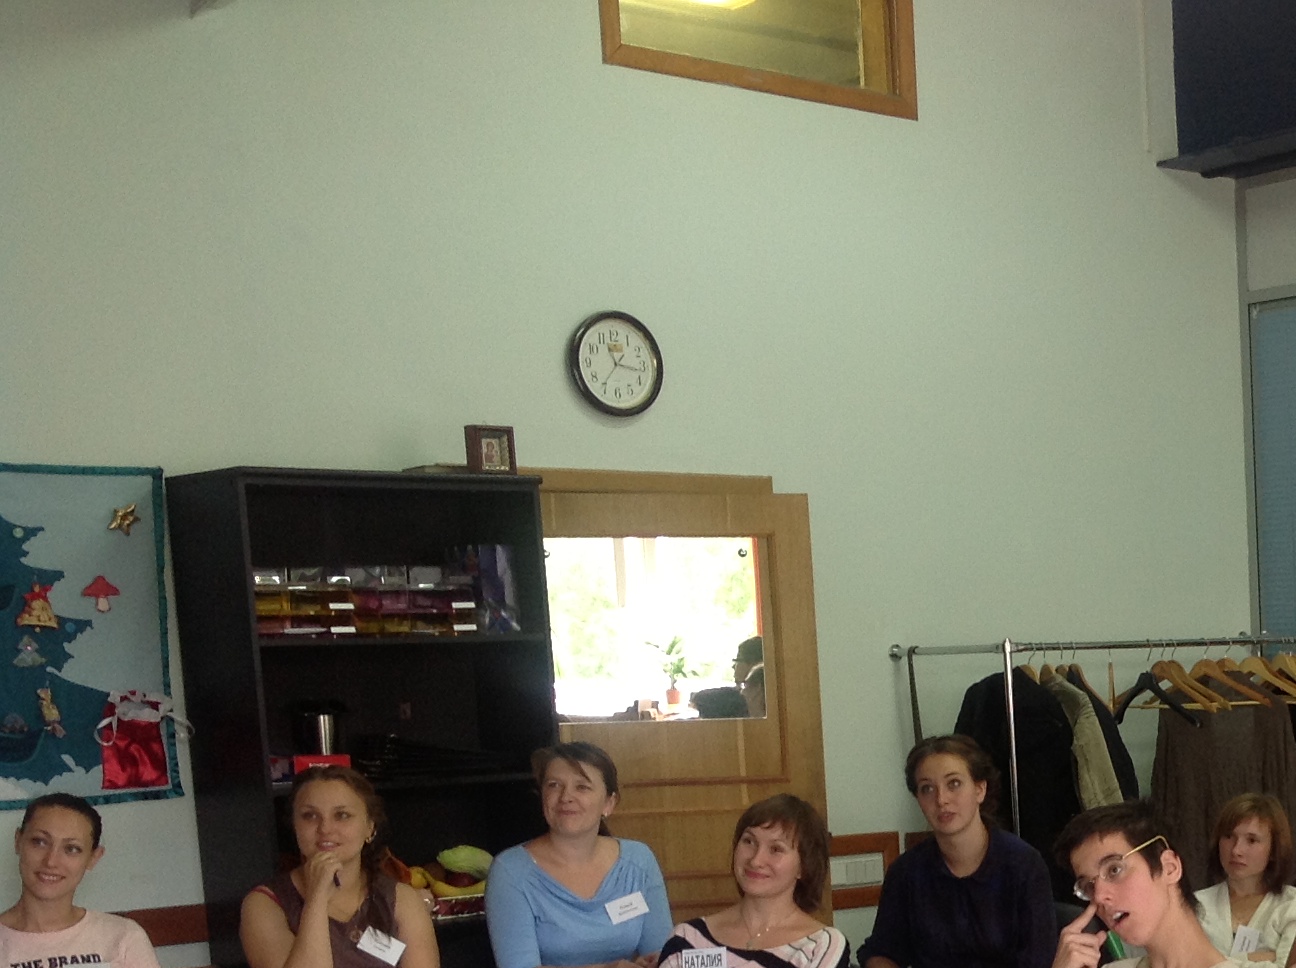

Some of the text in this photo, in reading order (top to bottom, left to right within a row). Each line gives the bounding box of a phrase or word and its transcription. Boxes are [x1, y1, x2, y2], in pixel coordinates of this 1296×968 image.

[598, 332, 605, 345] 11
[609, 330, 619, 343] 12
[588, 343, 599, 355] 10
[635, 346, 641, 358] 2
[585, 358, 591, 368] 9
[638, 360, 646, 372] 3
[591, 371, 598, 383] 8
[637, 375, 642, 387] 4
[602, 383, 607, 395] 7
[615, 388, 621, 399] 6
[627, 385, 633, 396] 5
[47, 953, 102, 968] BRAND
